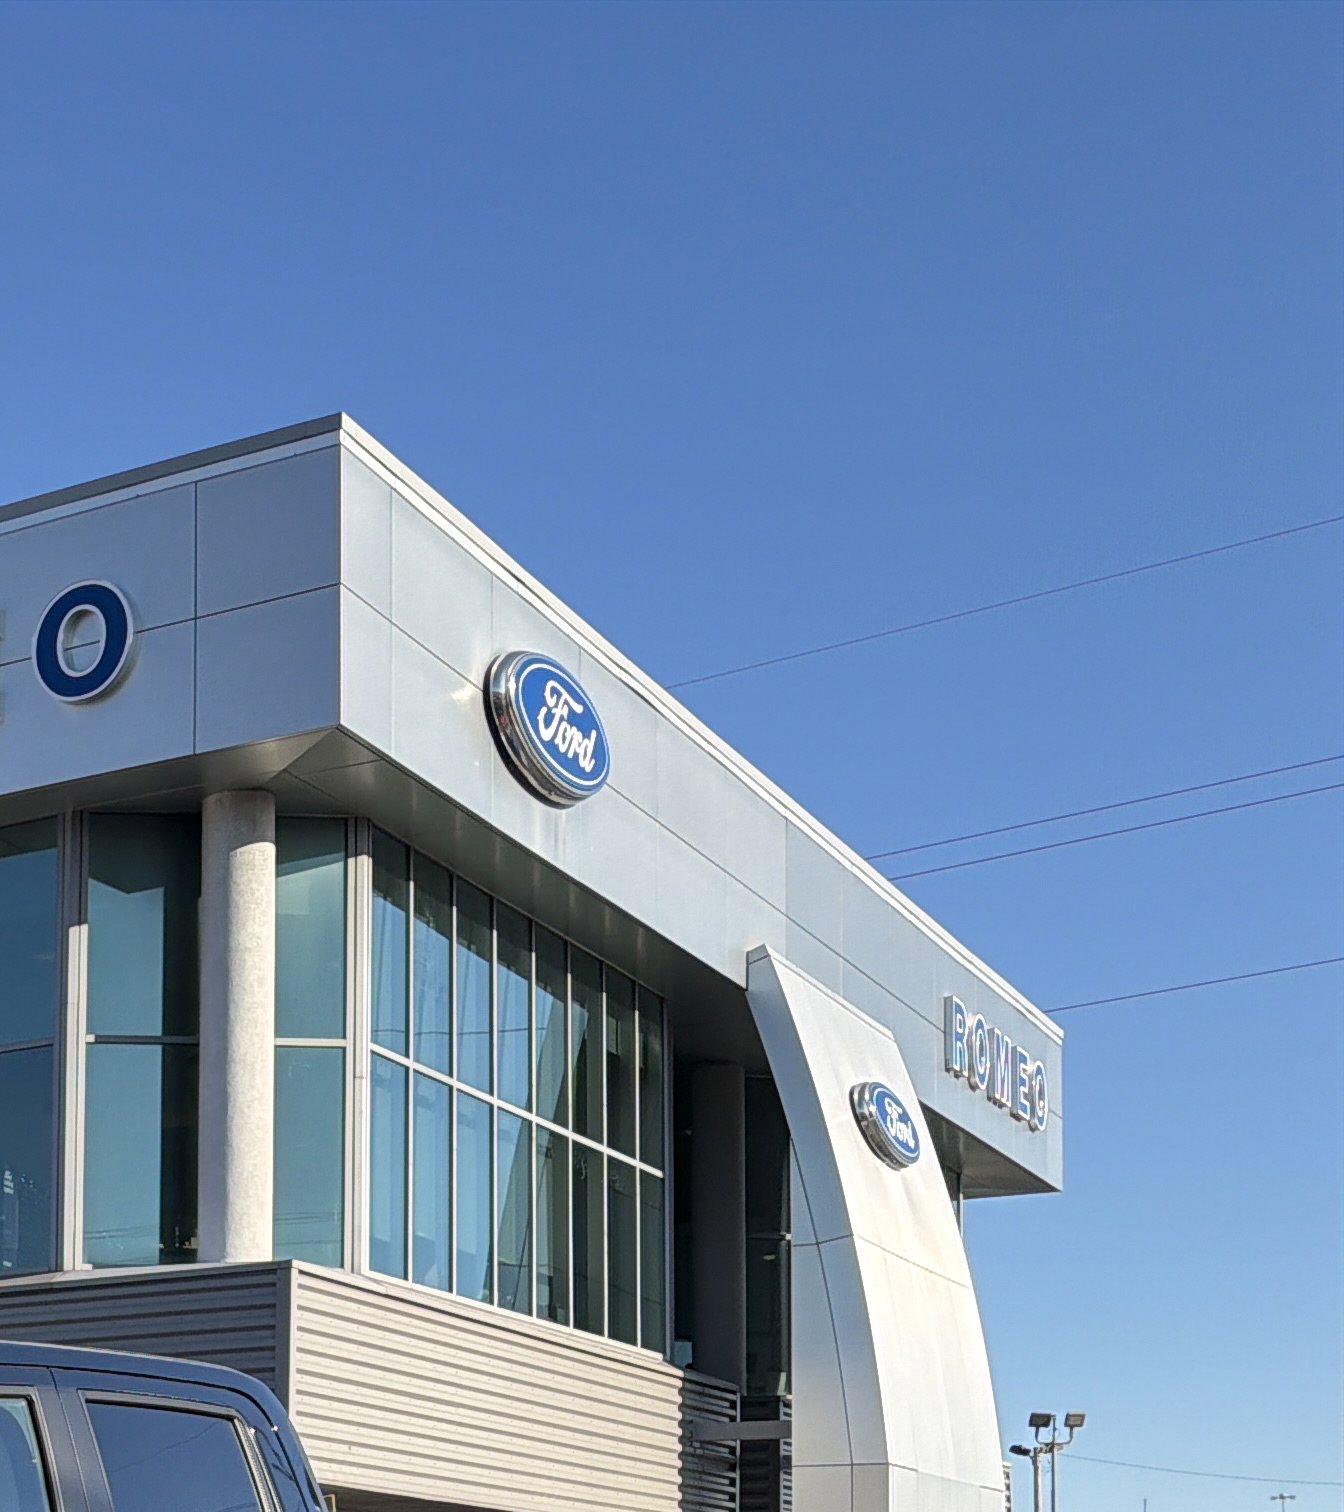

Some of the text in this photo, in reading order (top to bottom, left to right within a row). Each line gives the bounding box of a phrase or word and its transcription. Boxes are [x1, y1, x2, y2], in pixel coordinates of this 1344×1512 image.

[538, 679, 597, 773] Ford
[946, 995, 1049, 1132] ROMEO
[884, 1097, 916, 1149] Ford
